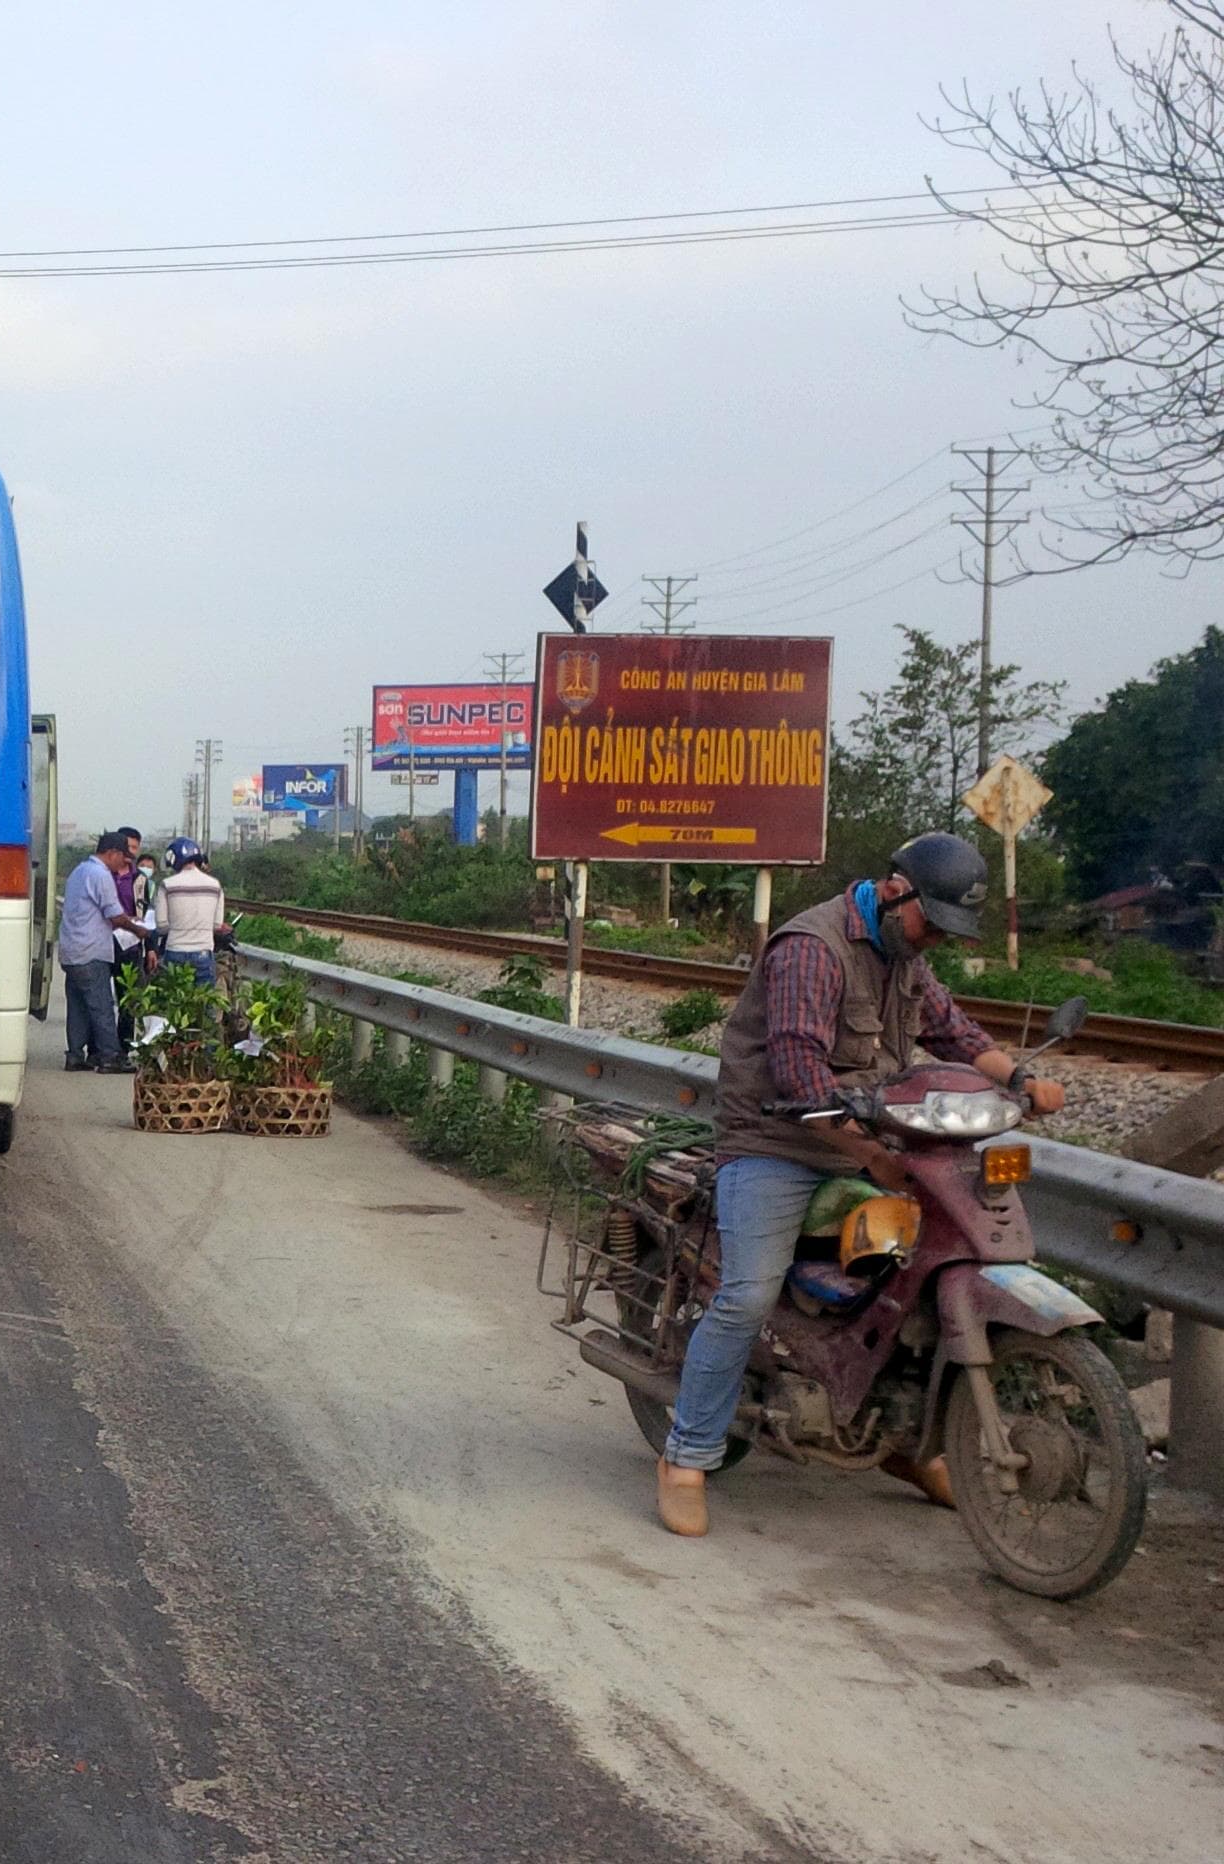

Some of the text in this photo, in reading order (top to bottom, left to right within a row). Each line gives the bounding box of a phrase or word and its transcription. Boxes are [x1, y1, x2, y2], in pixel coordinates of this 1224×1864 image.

[620, 666, 805, 696] CÔNG AN HUYỆN GIA LÂM
[407, 702, 524, 726] SUNPEC
[542, 706, 824, 794] ĐỘI CẢNH SÁT GIAO THÔNG
[285, 780, 327, 794] INFOR
[669, 829, 714, 841] 70M
